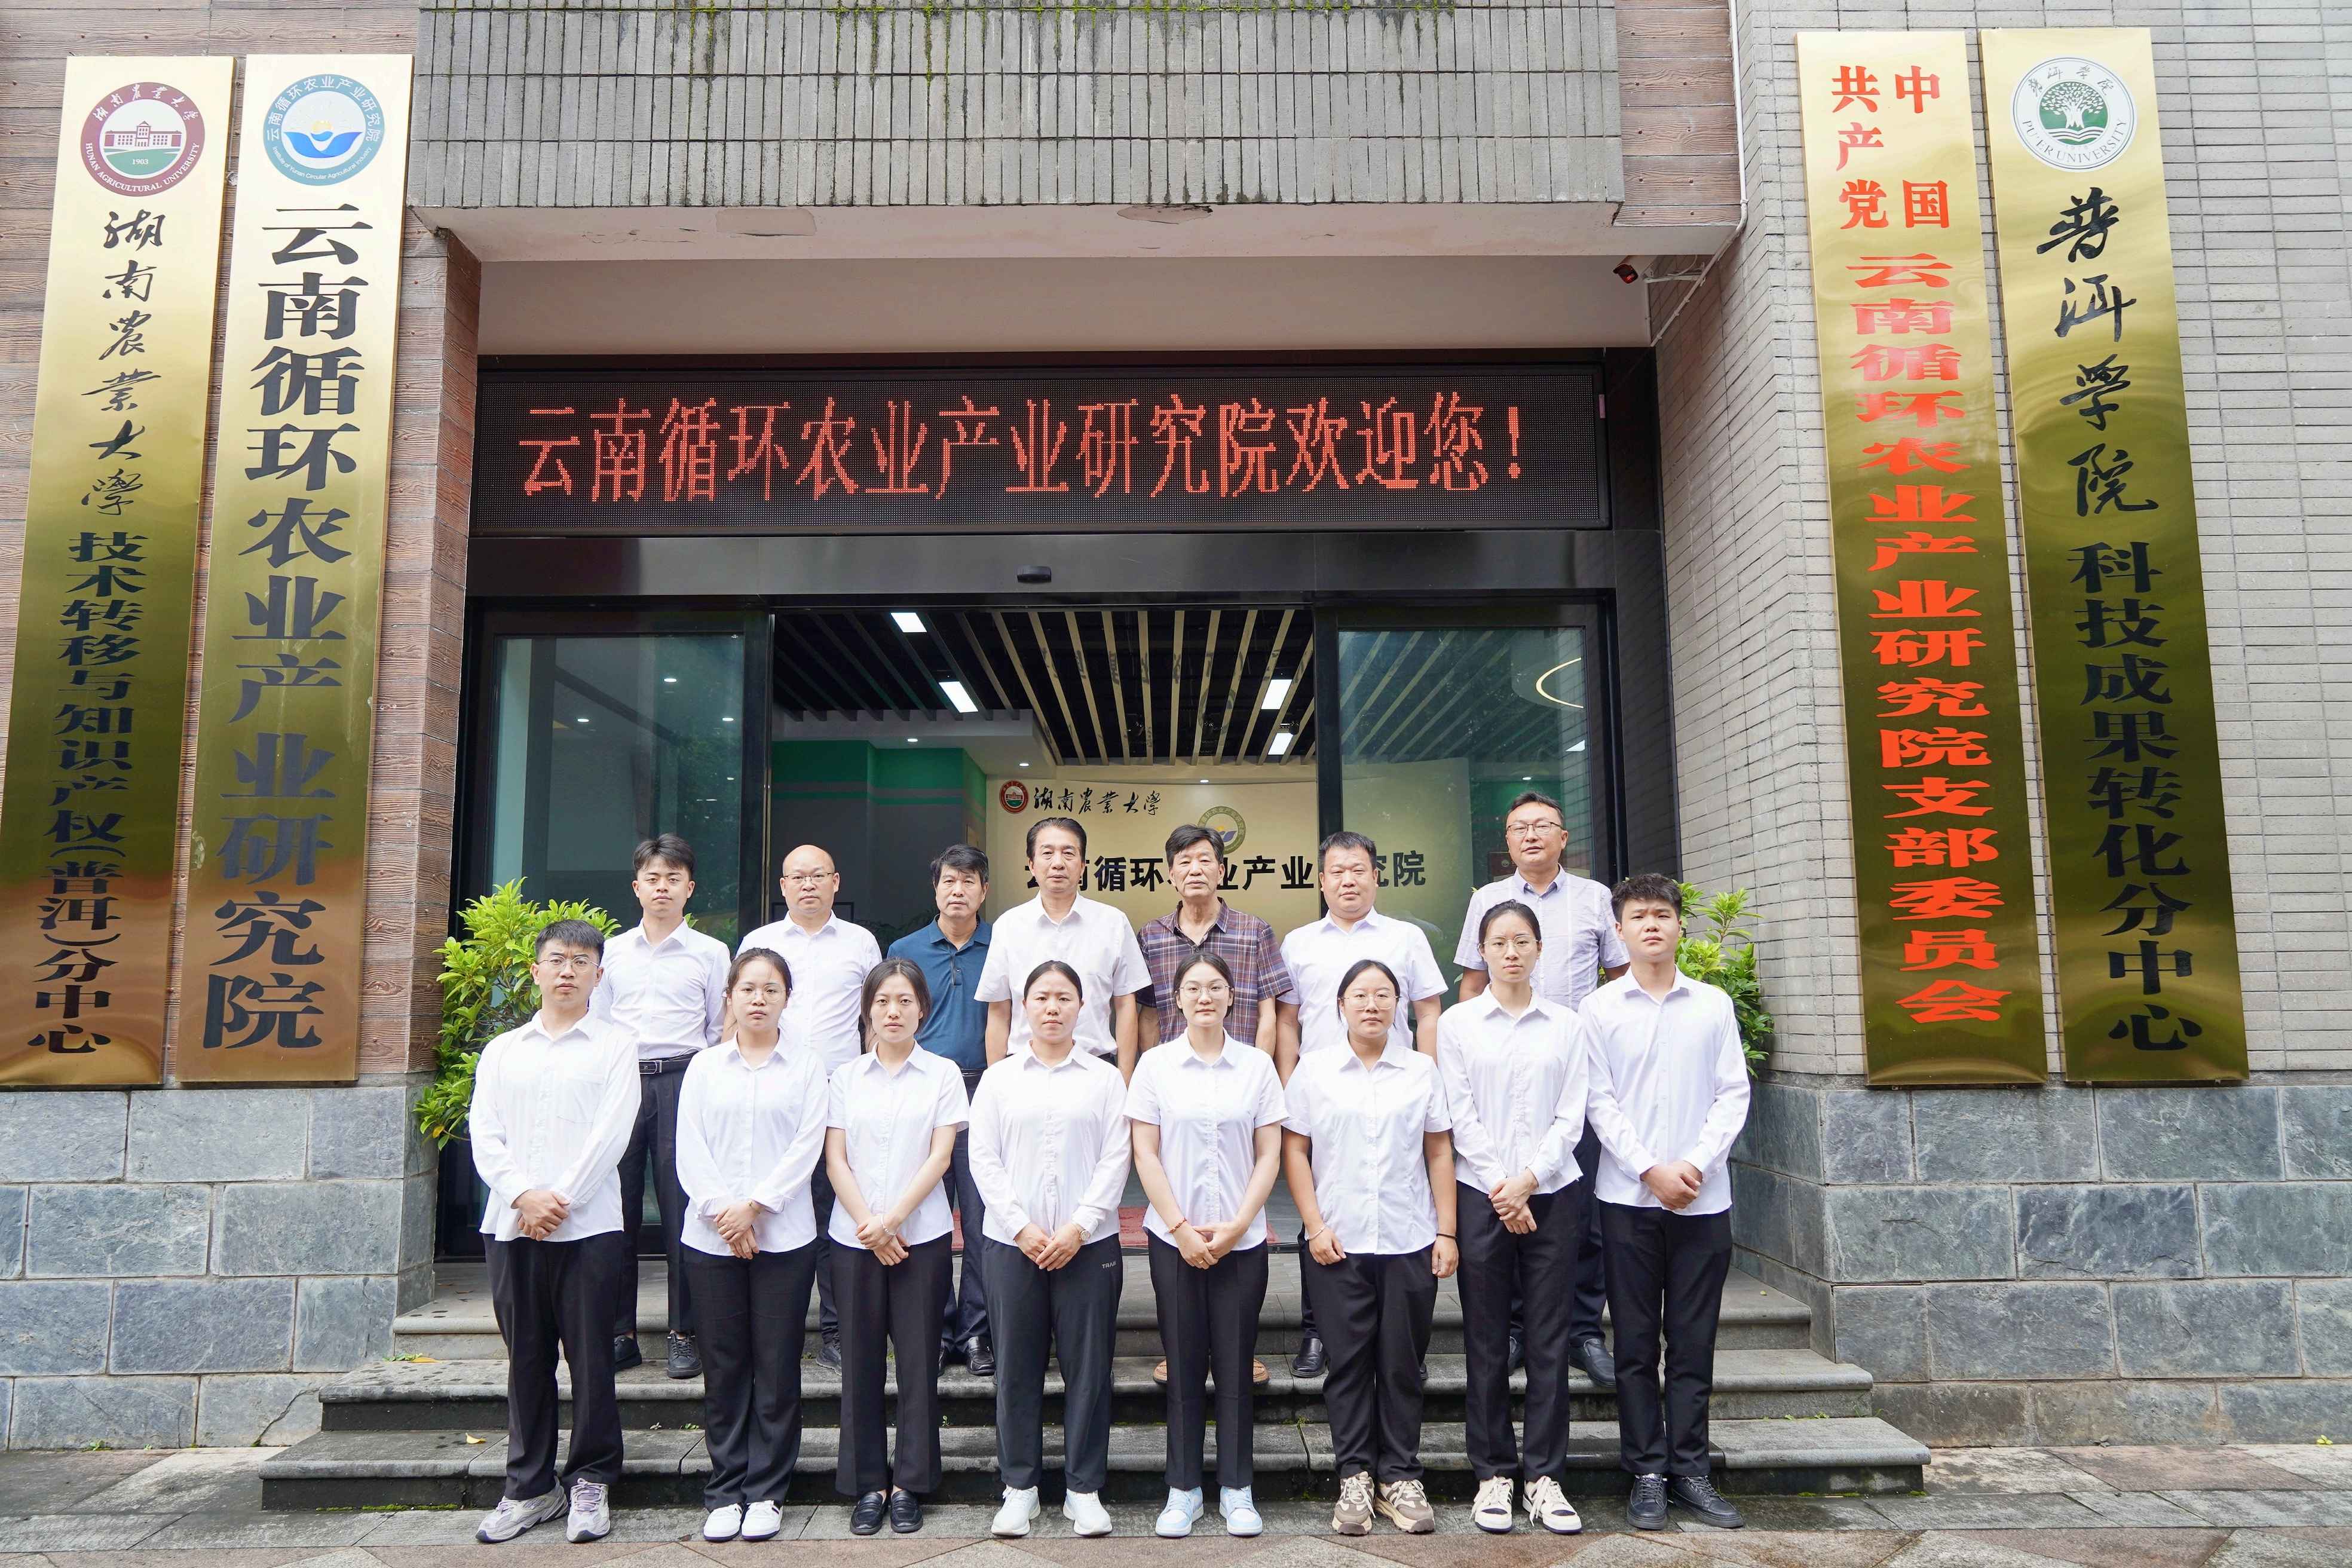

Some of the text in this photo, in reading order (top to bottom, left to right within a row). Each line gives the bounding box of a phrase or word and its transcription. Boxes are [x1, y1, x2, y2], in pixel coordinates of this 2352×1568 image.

[85, 142, 200, 192] HUNAN AGRICULTURAL UNIVERSITY
[267, 76, 381, 142] 云南循环农业产业研究院
[2056, 118, 2127, 163] UNIVERSITY
[203, 203, 373, 1049] 云南循环农业产业研究院
[1845, 253, 2011, 1024] 云南循环农业产业研究院支部委员会
[2066, 541, 2203, 1052] 科技成果转化分中心
